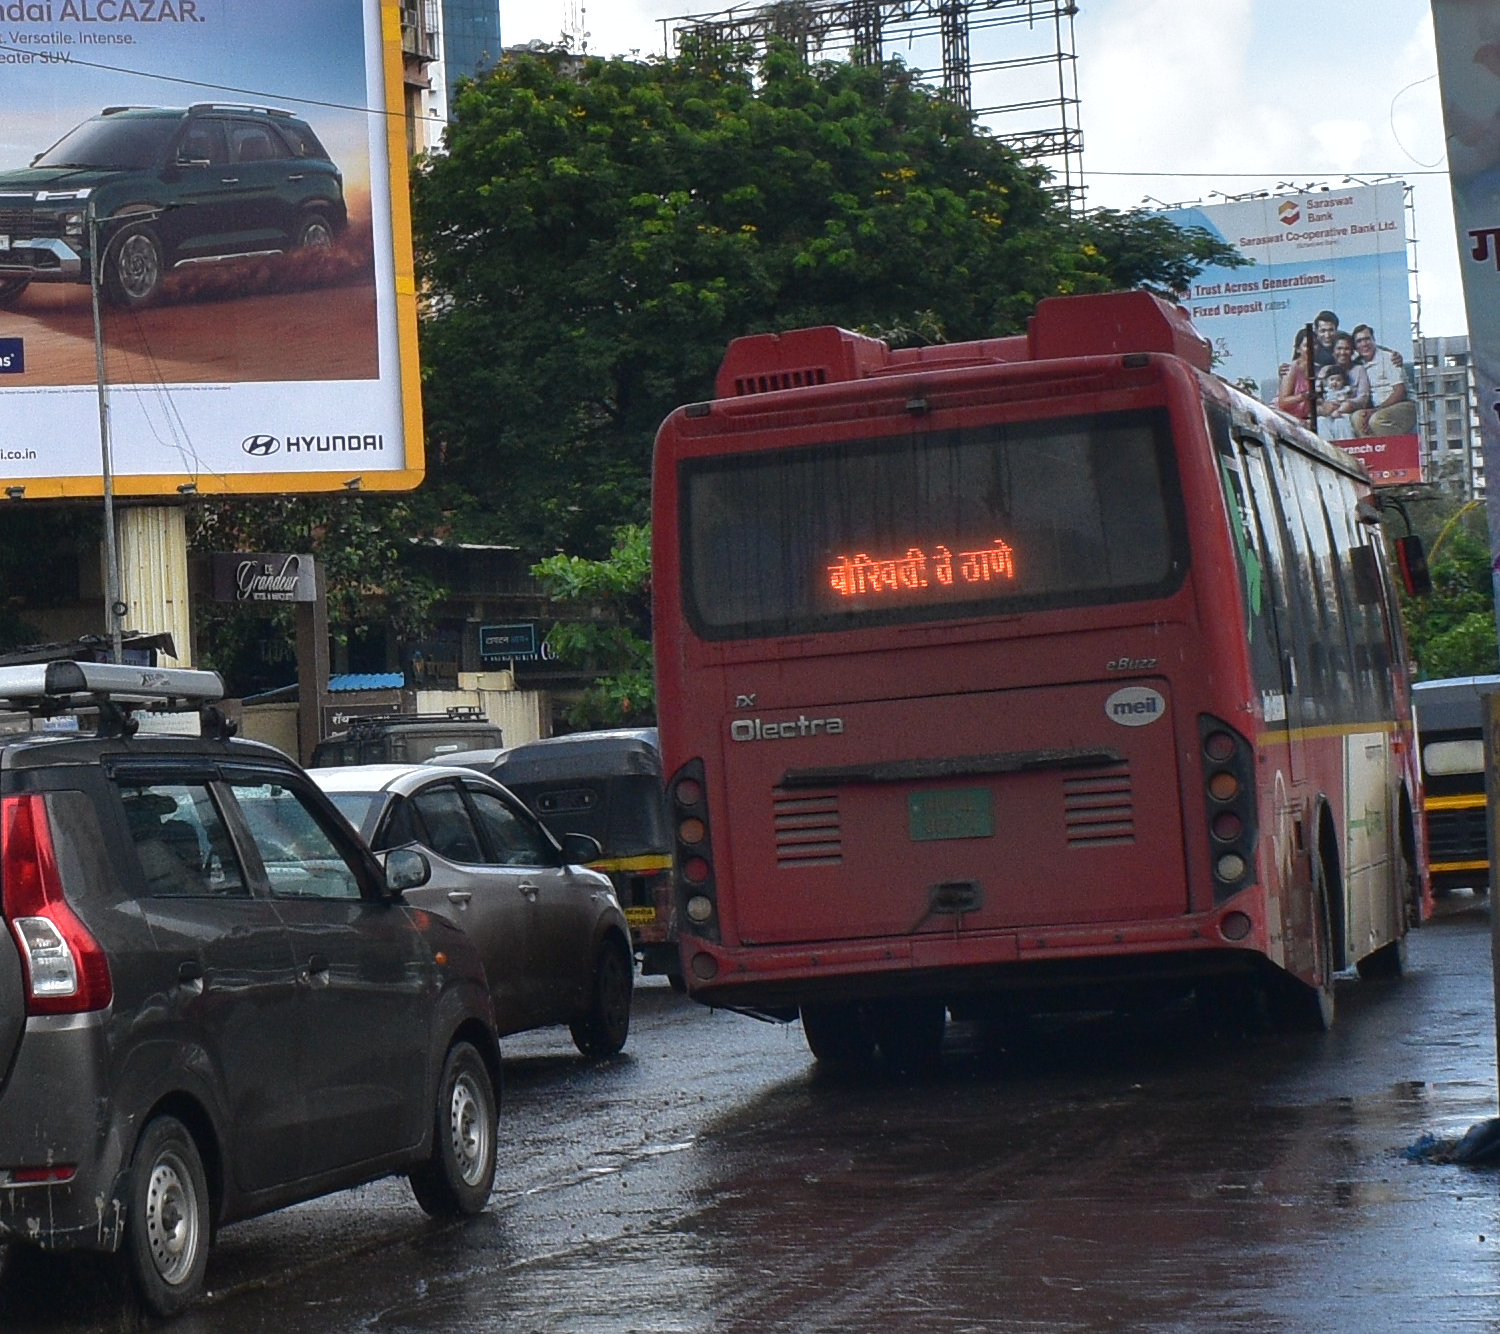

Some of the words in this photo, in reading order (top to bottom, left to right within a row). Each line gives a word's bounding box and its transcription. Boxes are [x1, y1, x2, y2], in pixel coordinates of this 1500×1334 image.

[59, 0, 206, 23] ALCAZAR.
[9, 32, 76, 45] Versatile.
[79, 32, 137, 45] Intense.
[1306, 196, 1354, 210] Saraswat
[1308, 212, 1333, 223] Bank
[1240, 233, 1284, 247] Saraswat
[1286, 227, 1348, 243] Co-operative
[1350, 223, 1376, 235] Bank
[1378, 221, 1398, 232] Ltd.
[1195, 283, 1221, 296] Trust
[1224, 280, 1259, 294] Across
[1192, 305, 1221, 317] Fixed
[1223, 300, 1263, 317] Deposit
[286, 434, 384, 453] HYUNDAI
[1343, 443, 1373, 454] ranch
[958, 539, 1013, 582] ठाणे
[1107, 657, 1157, 670] eBuzz
[1113, 698, 1157, 716] meil
[731, 716, 844, 742] Olectra
